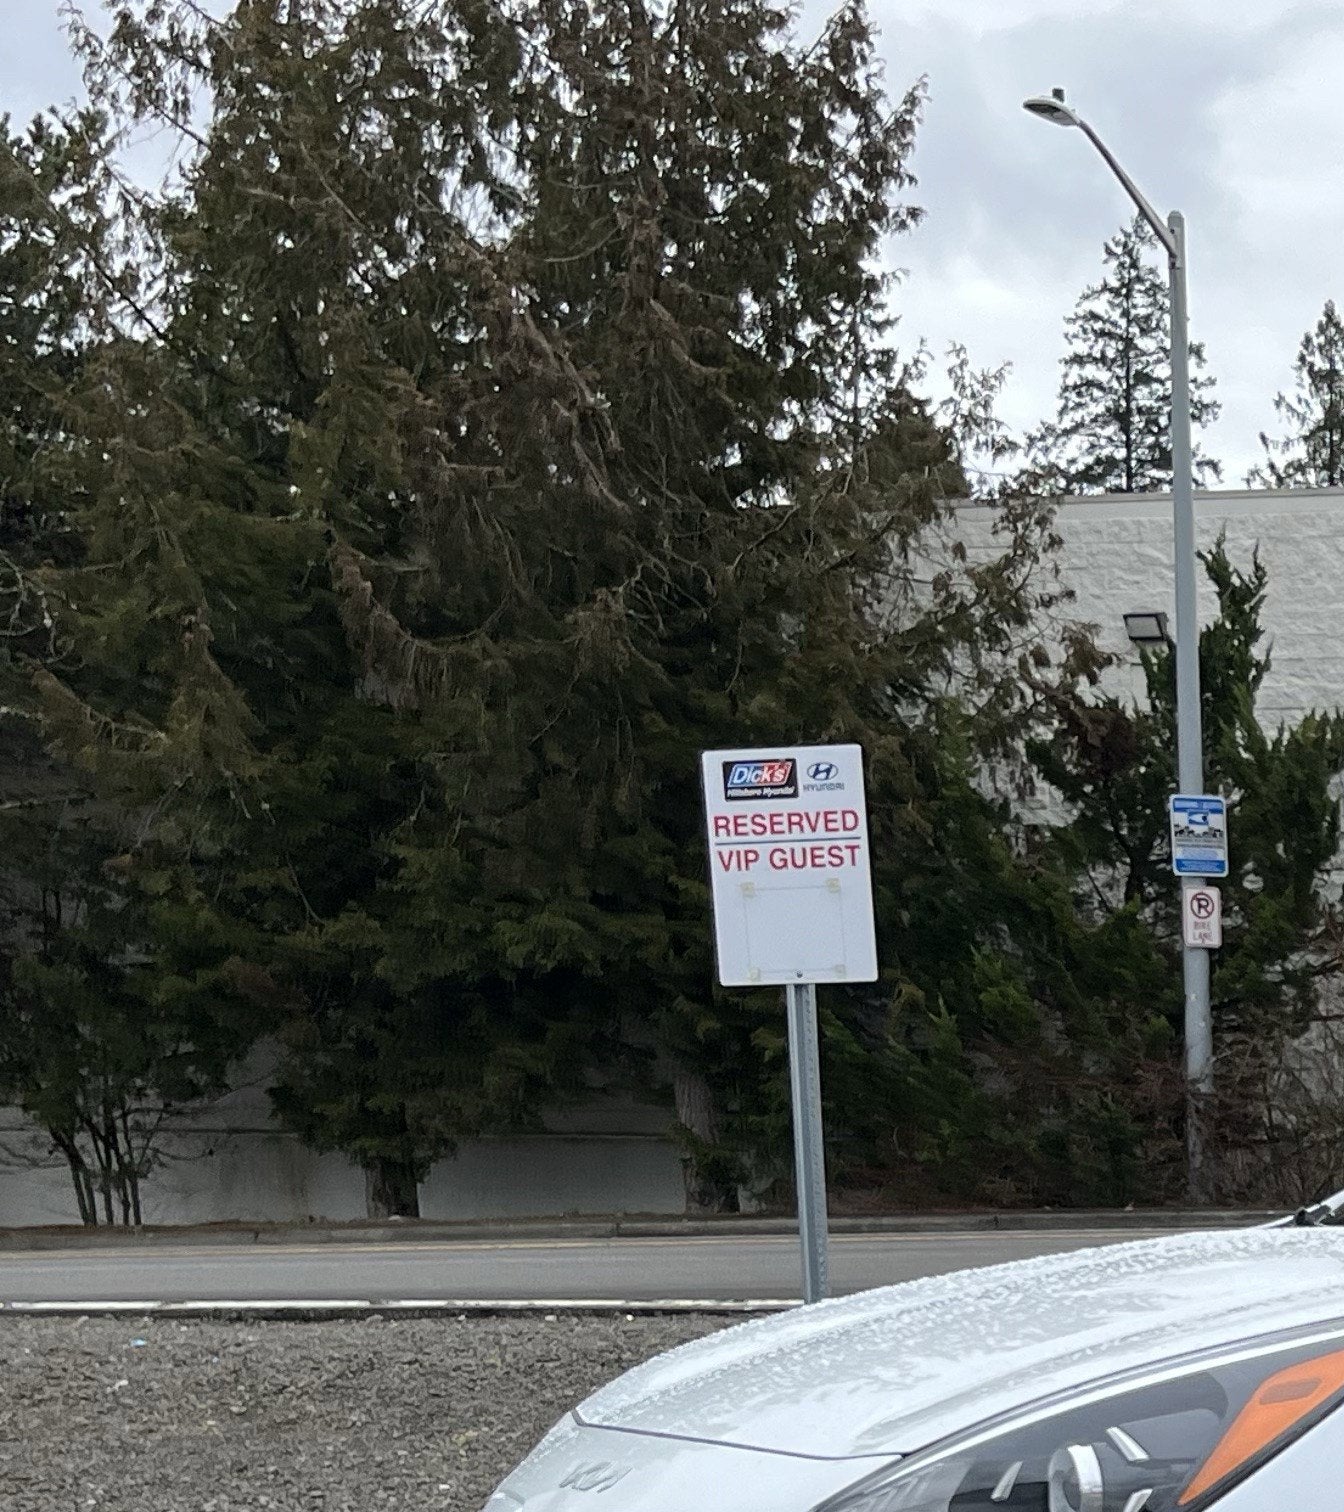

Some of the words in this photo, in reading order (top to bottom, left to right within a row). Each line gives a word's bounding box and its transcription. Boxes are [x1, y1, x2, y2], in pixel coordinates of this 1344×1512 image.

[713, 810, 860, 838] RESERVED
[717, 849, 760, 872] VIP
[769, 844, 861, 871] GUEST
